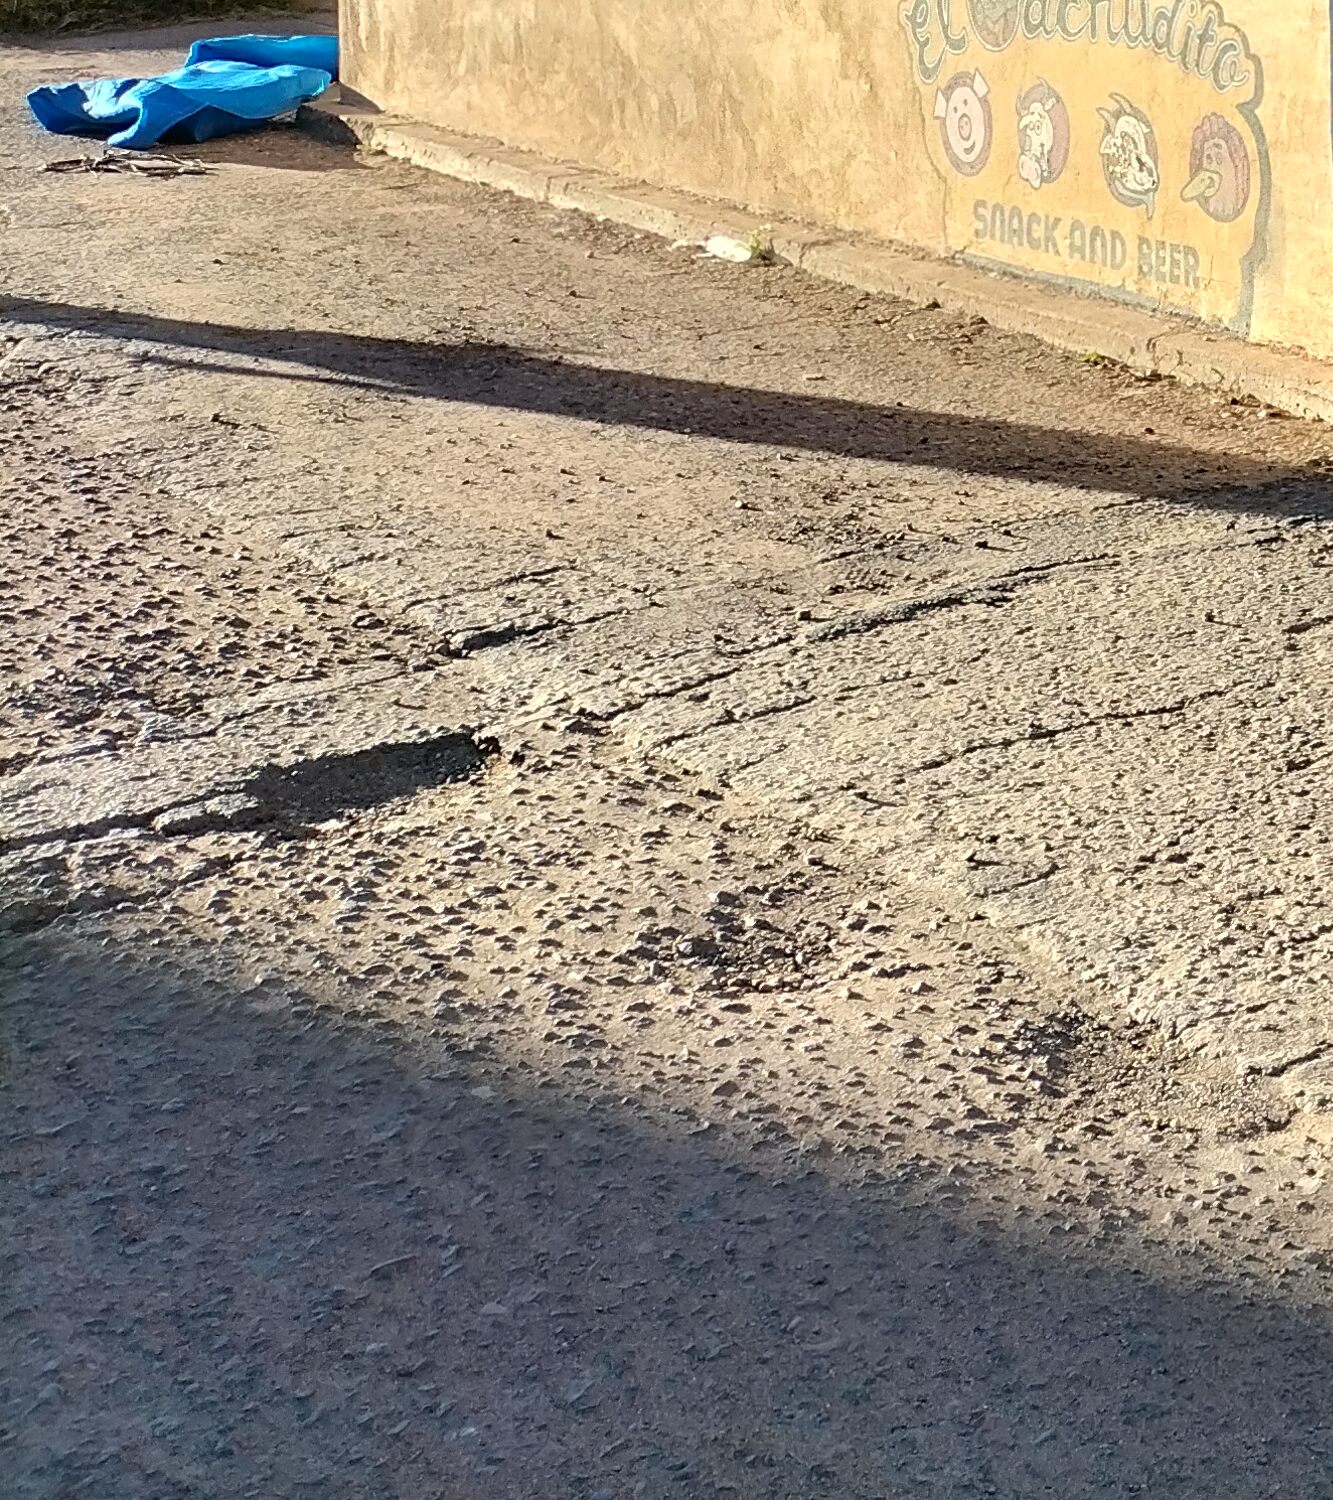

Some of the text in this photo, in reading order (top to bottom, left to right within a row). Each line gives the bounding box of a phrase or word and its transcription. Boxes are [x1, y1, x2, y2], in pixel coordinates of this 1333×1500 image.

[972, 198, 1201, 290] SNACK AND BEER
